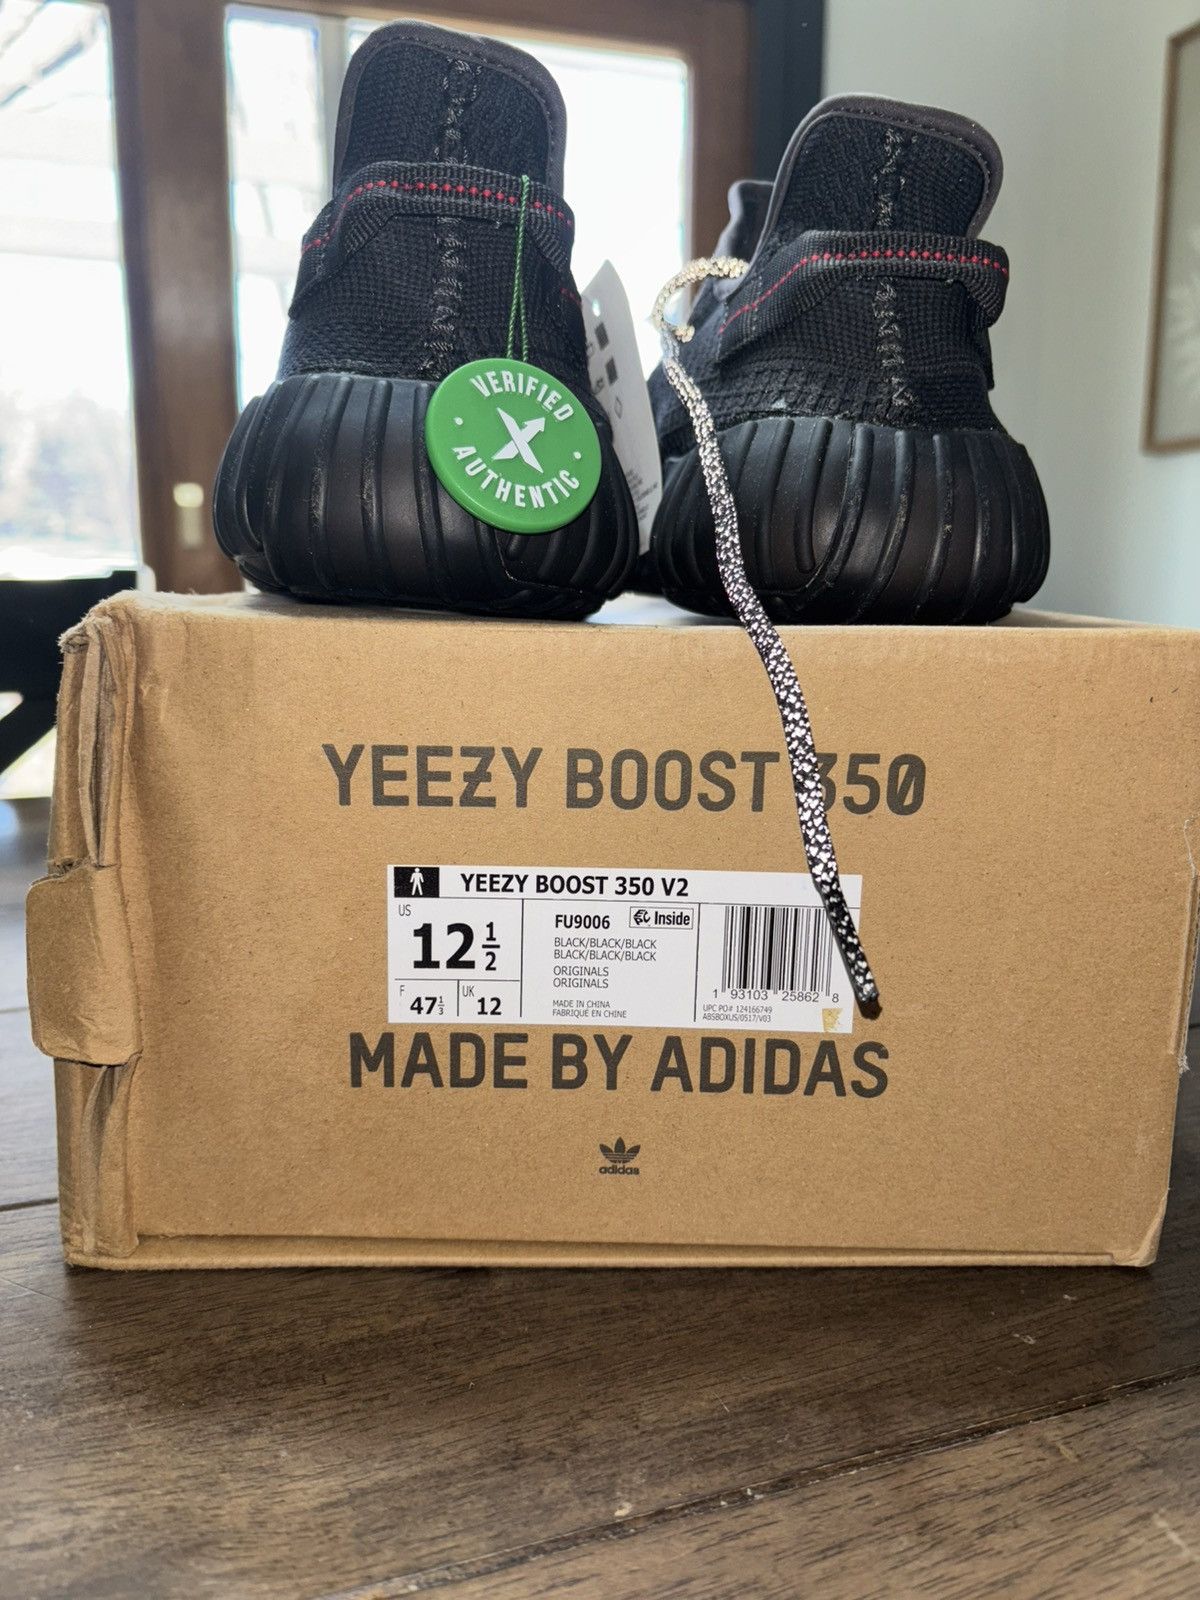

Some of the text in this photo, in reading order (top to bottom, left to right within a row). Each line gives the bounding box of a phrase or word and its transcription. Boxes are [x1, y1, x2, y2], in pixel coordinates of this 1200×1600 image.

[470, 369, 575, 422] VERIFIED
[451, 445, 580, 510] AUTHENTIC
[321, 743, 543, 808] YEEZY
[566, 747, 780, 813] BOOST
[461, 873, 689, 897] YEEZY BOOST 350 V2
[398, 904, 411, 916] US
[555, 914, 610, 929] FU9006
[654, 911, 690, 926] Inside
[413, 922, 475, 969] 12
[554, 937, 657, 949] BLACK/BLACK/BLACK
[554, 949, 656, 961] BLACK/BLACK/BLACK
[553, 965, 609, 977] ORIGINALS
[553, 977, 609, 989] ORIGINALS
[399, 985, 405, 996] F
[462, 985, 475, 997] UK
[713, 988, 839, 1003] 1 93103 25862 8
[410, 996, 437, 1015] 47
[477, 996, 502, 1015] 12
[552, 1000, 610, 1009] MADE IN CHINA
[703, 1004, 717, 1012] UPC
[552, 1008, 627, 1019] FABRIQUE EN CHINE
[349, 1032, 889, 1098] MADE BY ADIDAS
[599, 1164, 640, 1175] adidas
